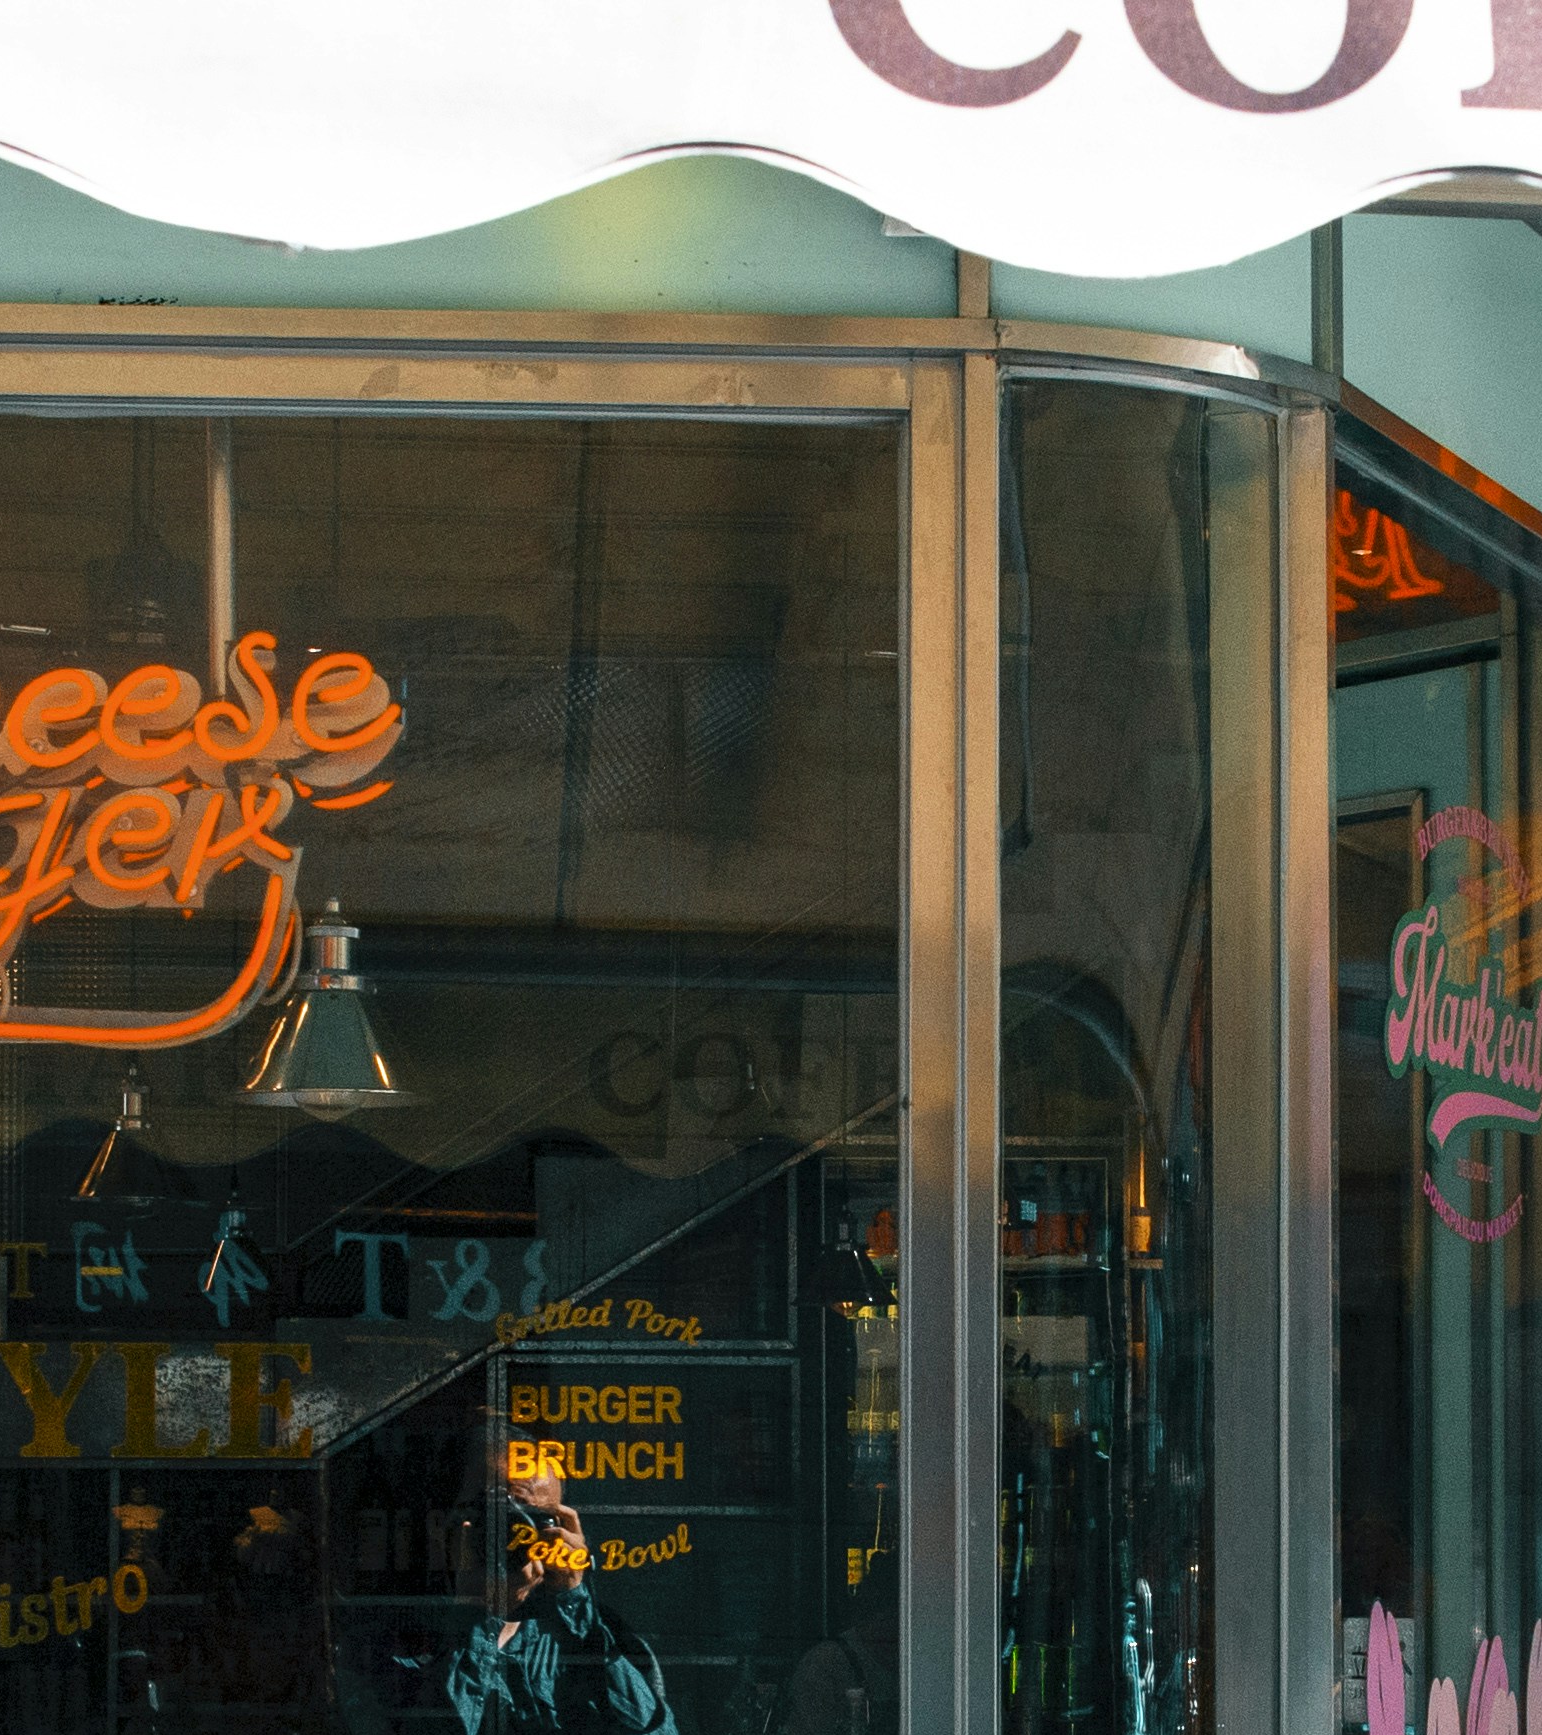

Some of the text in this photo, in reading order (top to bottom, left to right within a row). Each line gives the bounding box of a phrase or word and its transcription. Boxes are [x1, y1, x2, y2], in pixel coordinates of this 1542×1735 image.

[495, 1298, 703, 1348] Grilled Pork
[508, 1384, 682, 1426] BURGER
[506, 1438, 686, 1482] BRUNCH
[505, 1522, 693, 1573] Poke Bowl
